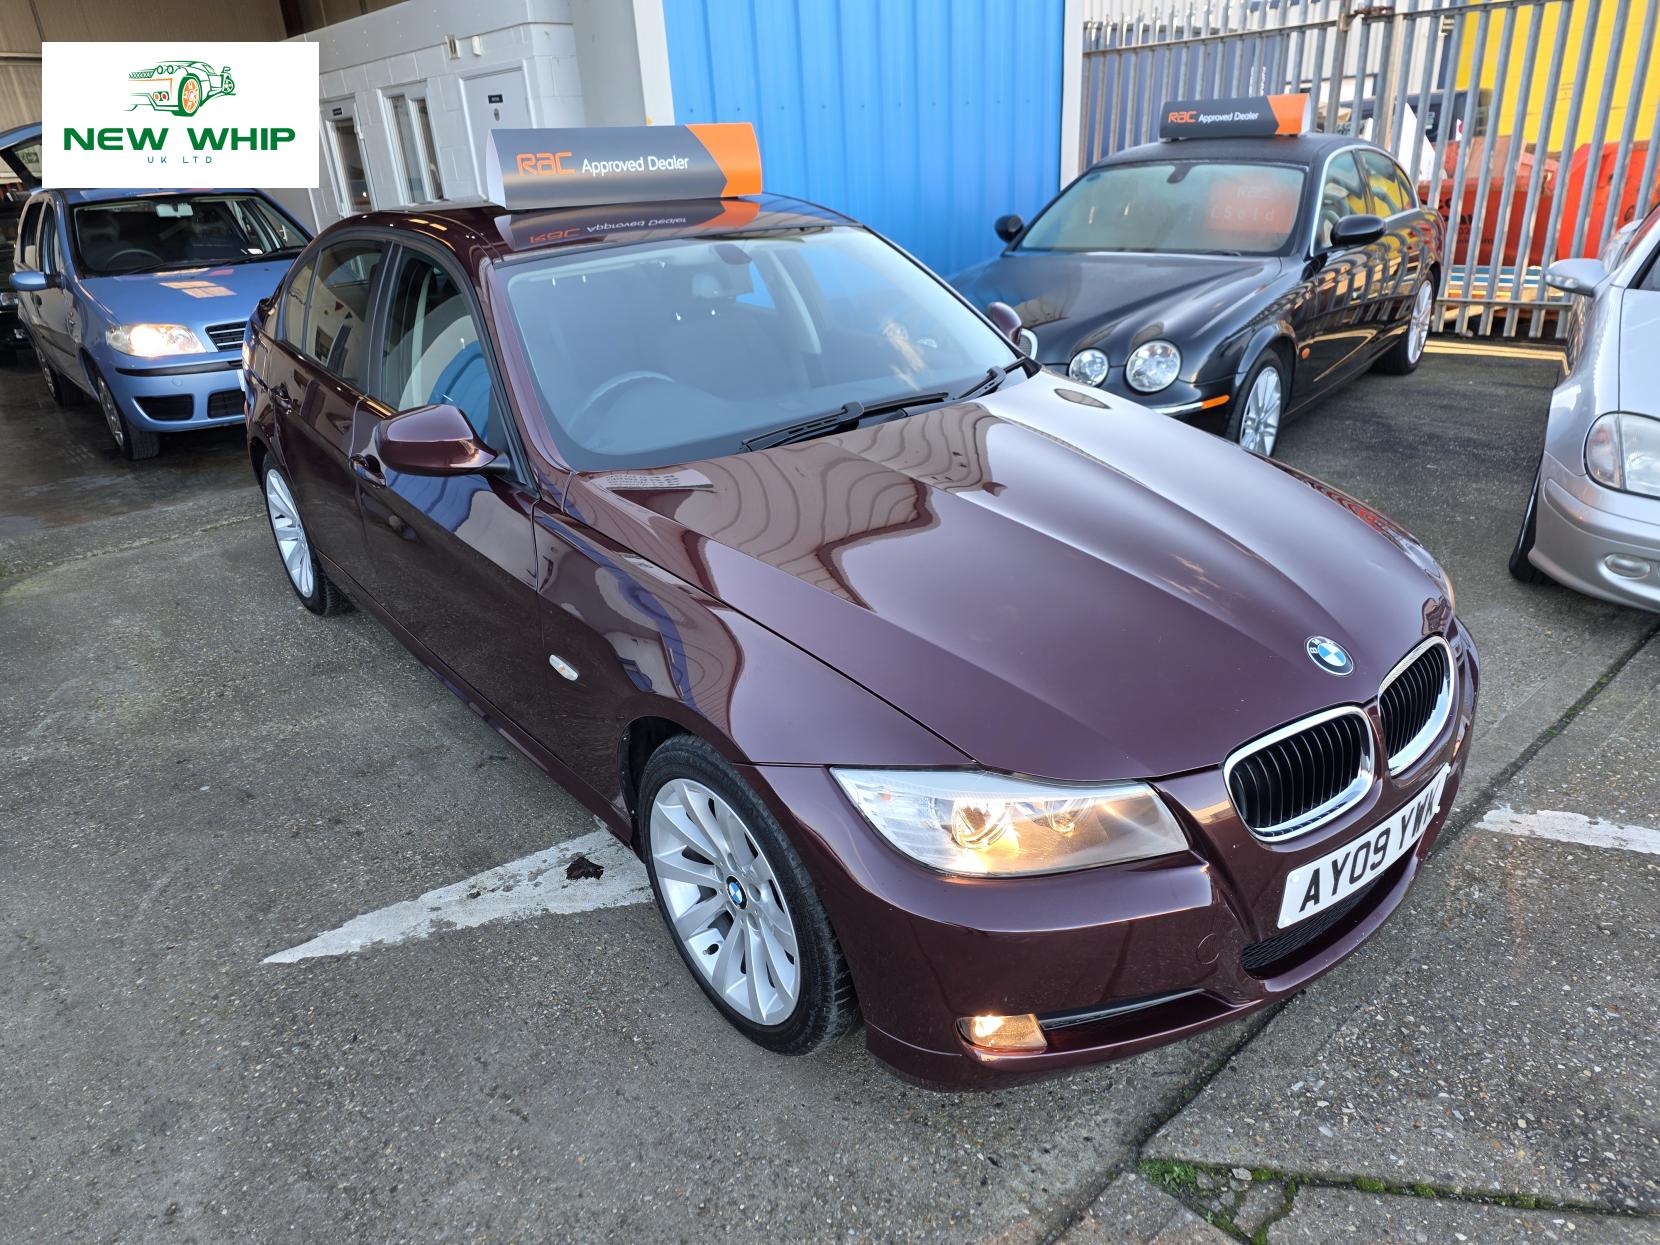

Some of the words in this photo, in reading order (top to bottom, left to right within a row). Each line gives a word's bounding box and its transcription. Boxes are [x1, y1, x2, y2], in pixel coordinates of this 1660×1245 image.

[1198, 112, 1234, 124] Approved
[1233, 111, 1259, 121] Dealer
[582, 156, 645, 176] Approved
[647, 155, 689, 171] Dealer
[1299, 827, 1391, 913] AY09
